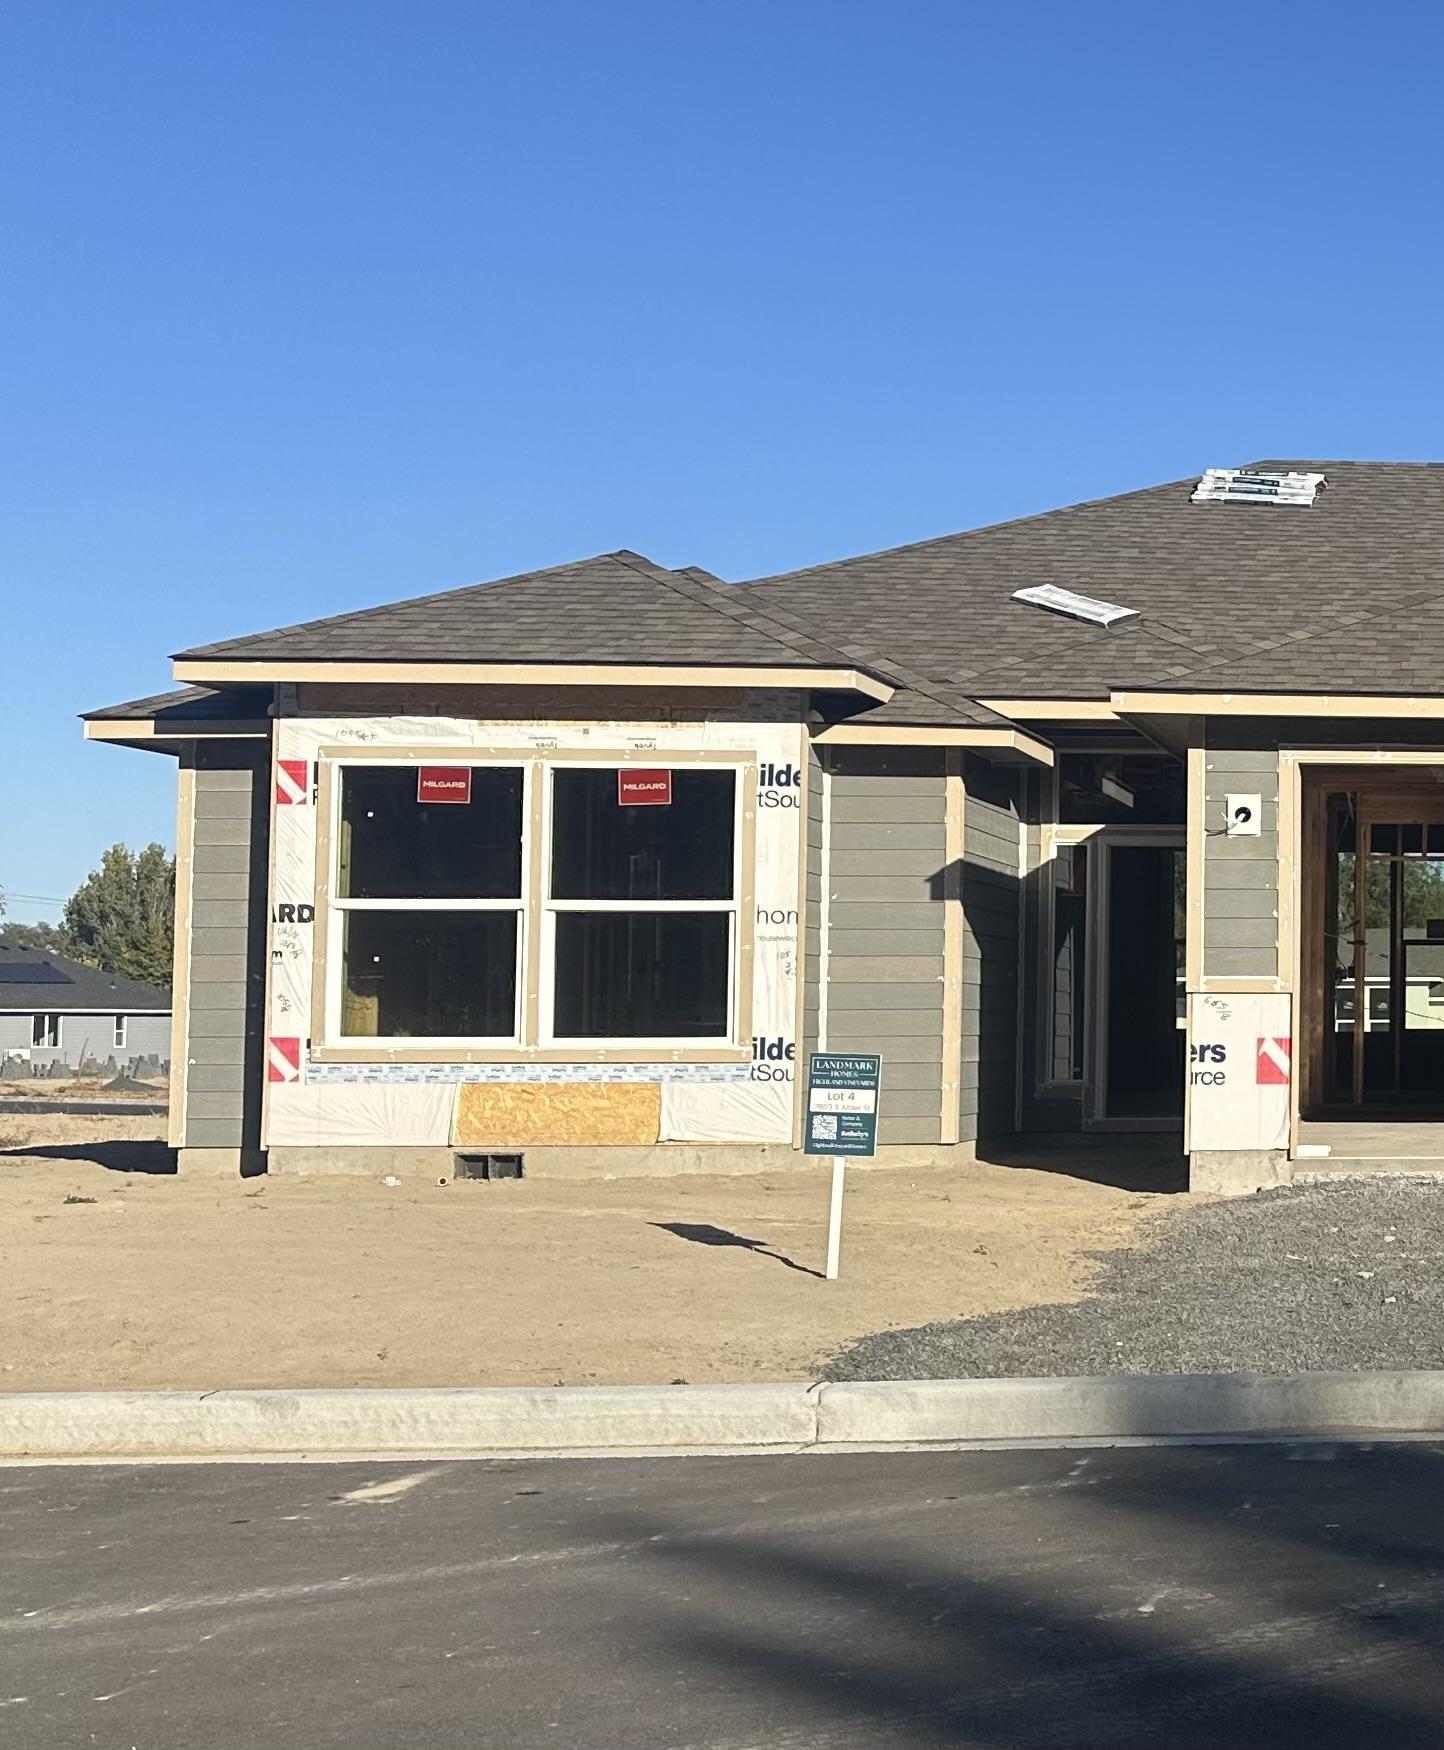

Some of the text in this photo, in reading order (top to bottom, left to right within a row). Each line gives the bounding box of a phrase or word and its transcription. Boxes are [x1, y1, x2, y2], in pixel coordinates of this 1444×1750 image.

[423, 780, 467, 789] MILGARD
[624, 783, 667, 791] MILGARD
[816, 1060, 874, 1071] LANDMARK
[830, 1070, 859, 1078] HOMES
[827, 1091, 855, 1102] Lot 4
